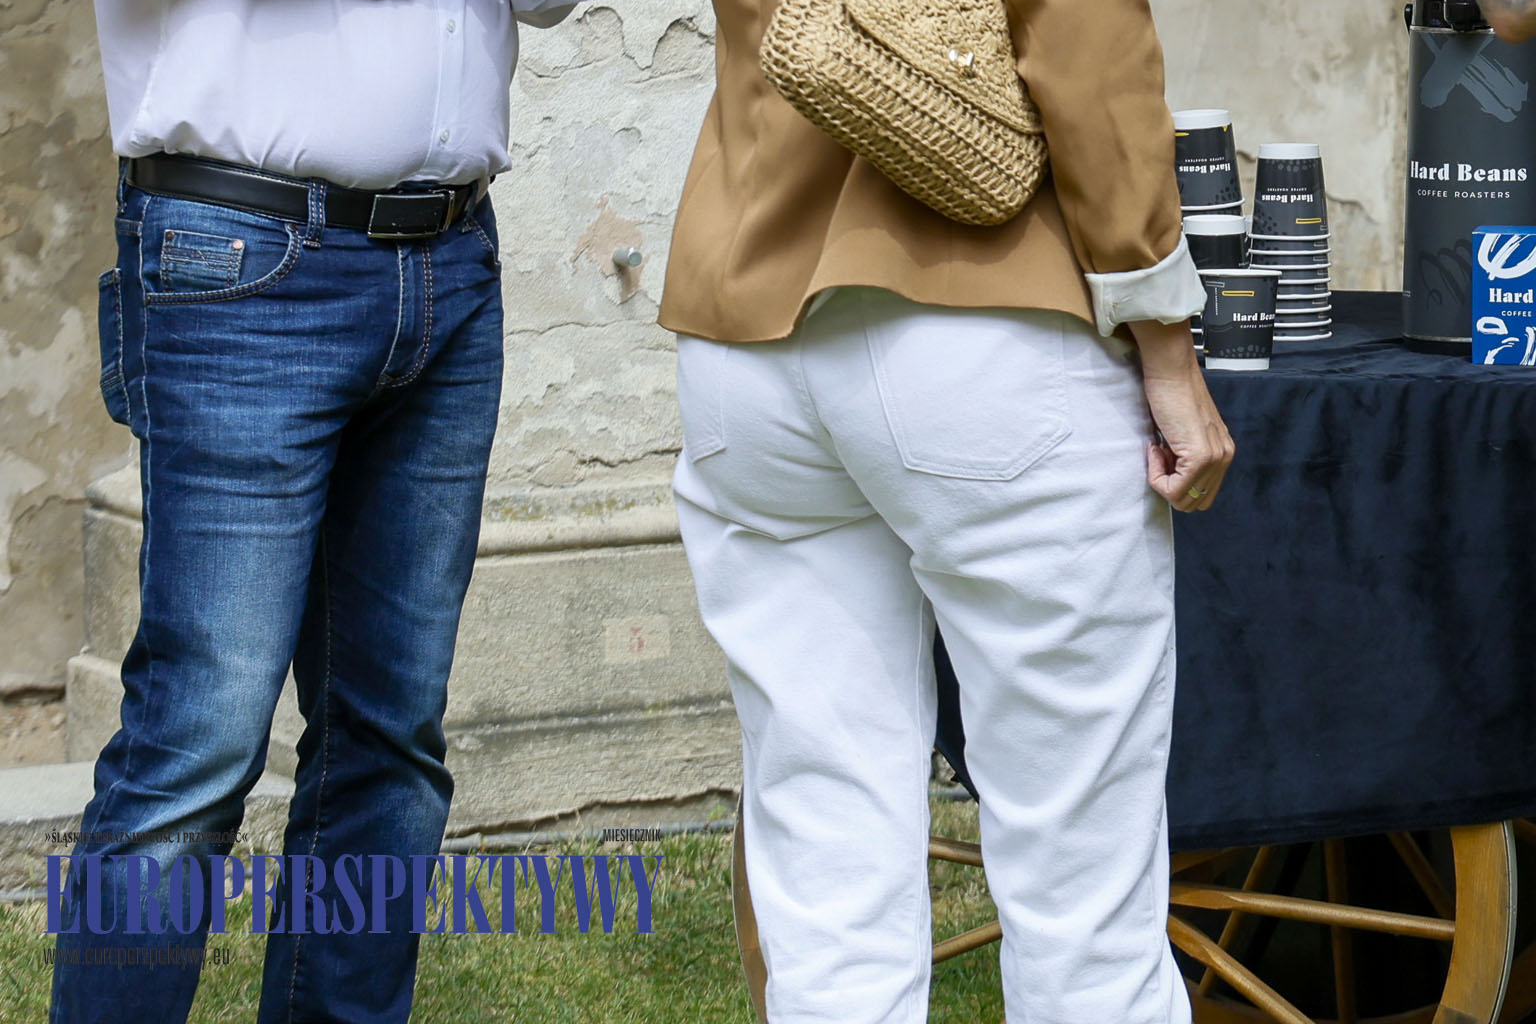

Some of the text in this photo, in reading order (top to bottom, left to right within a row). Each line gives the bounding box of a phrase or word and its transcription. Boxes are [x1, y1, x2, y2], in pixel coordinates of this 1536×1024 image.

[1179, 163, 1230, 174] Hard Beans
[1410, 160, 1528, 182] Hard Beans
[1262, 194, 1313, 202] Hard Beans
[1418, 188, 1510, 199] COFFEE ROASTERS
[1488, 288, 1534, 304] Hard
[1233, 312, 1258, 322] Hard
[1501, 310, 1532, 318] COFFEE
